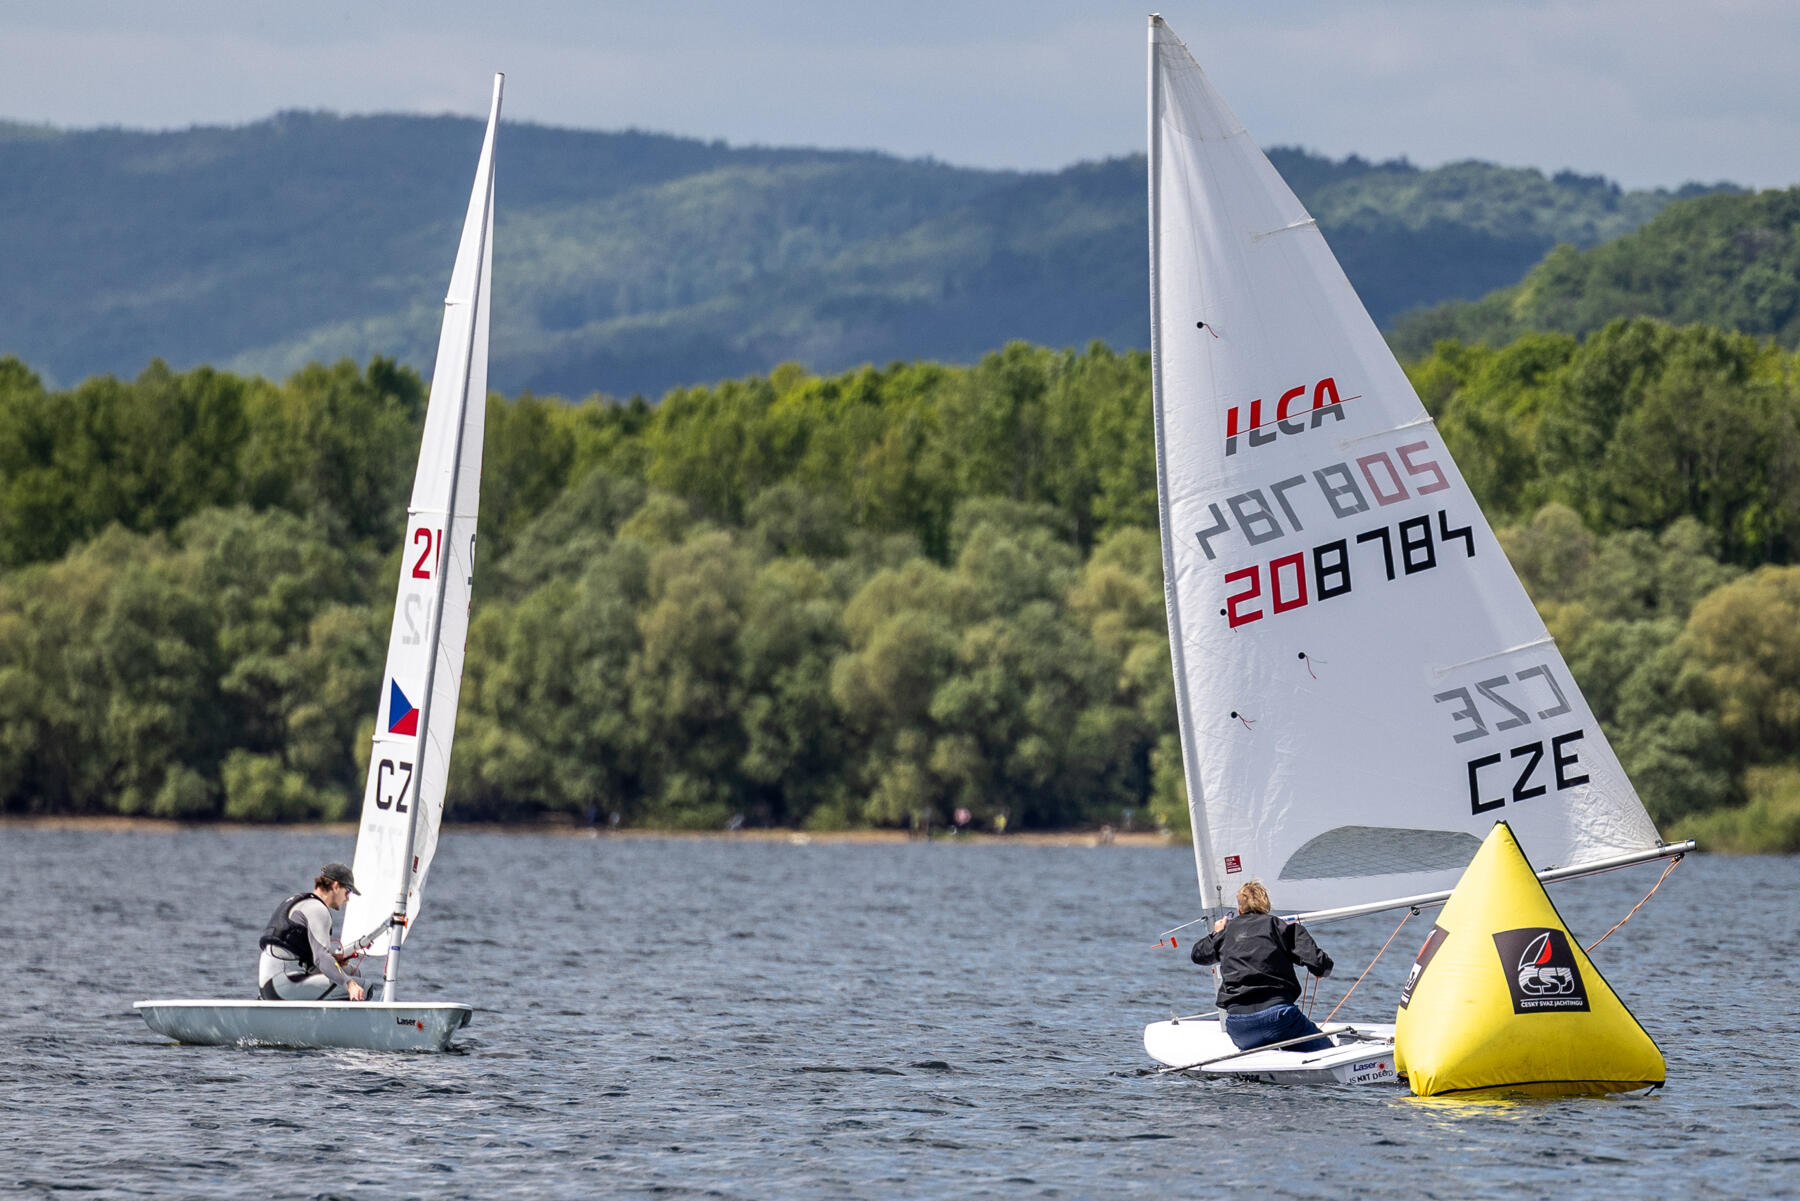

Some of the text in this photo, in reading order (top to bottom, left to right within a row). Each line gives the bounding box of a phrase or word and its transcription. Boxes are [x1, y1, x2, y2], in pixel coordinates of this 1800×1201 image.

[1225, 377, 1346, 456] ILCA
[1224, 509, 1476, 629] 208784
[1467, 729, 1590, 815] CZE
[1354, 1062, 1377, 1071] Laser
